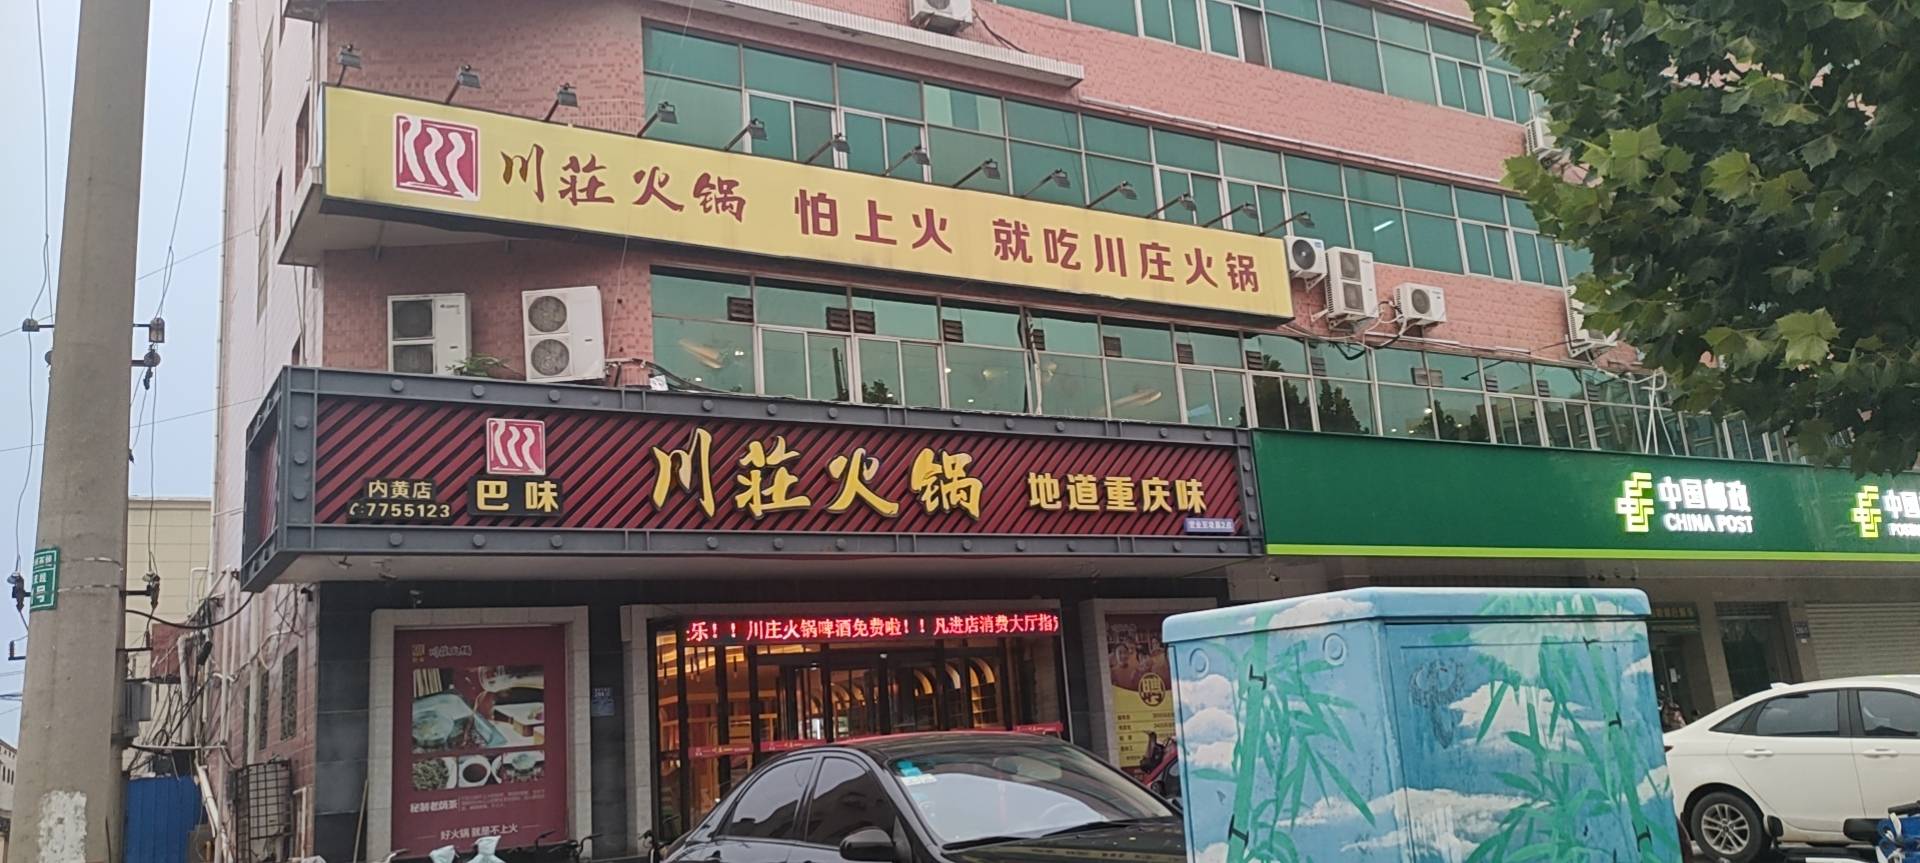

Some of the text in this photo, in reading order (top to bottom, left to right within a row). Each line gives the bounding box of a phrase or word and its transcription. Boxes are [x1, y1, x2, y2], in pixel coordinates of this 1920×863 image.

[794, 189, 953, 254] 怕上火
[992, 218, 1260, 293] 就吃川庄火锅
[368, 480, 433, 499] 内黄店
[477, 480, 559, 513] 巴味
[1027, 471, 1207, 514] 地道重庆味
[1657, 476, 1751, 512] 中国邮政
[1881, 489, 1920, 519] 中国
[1663, 512, 1753, 533] CHINA POST
